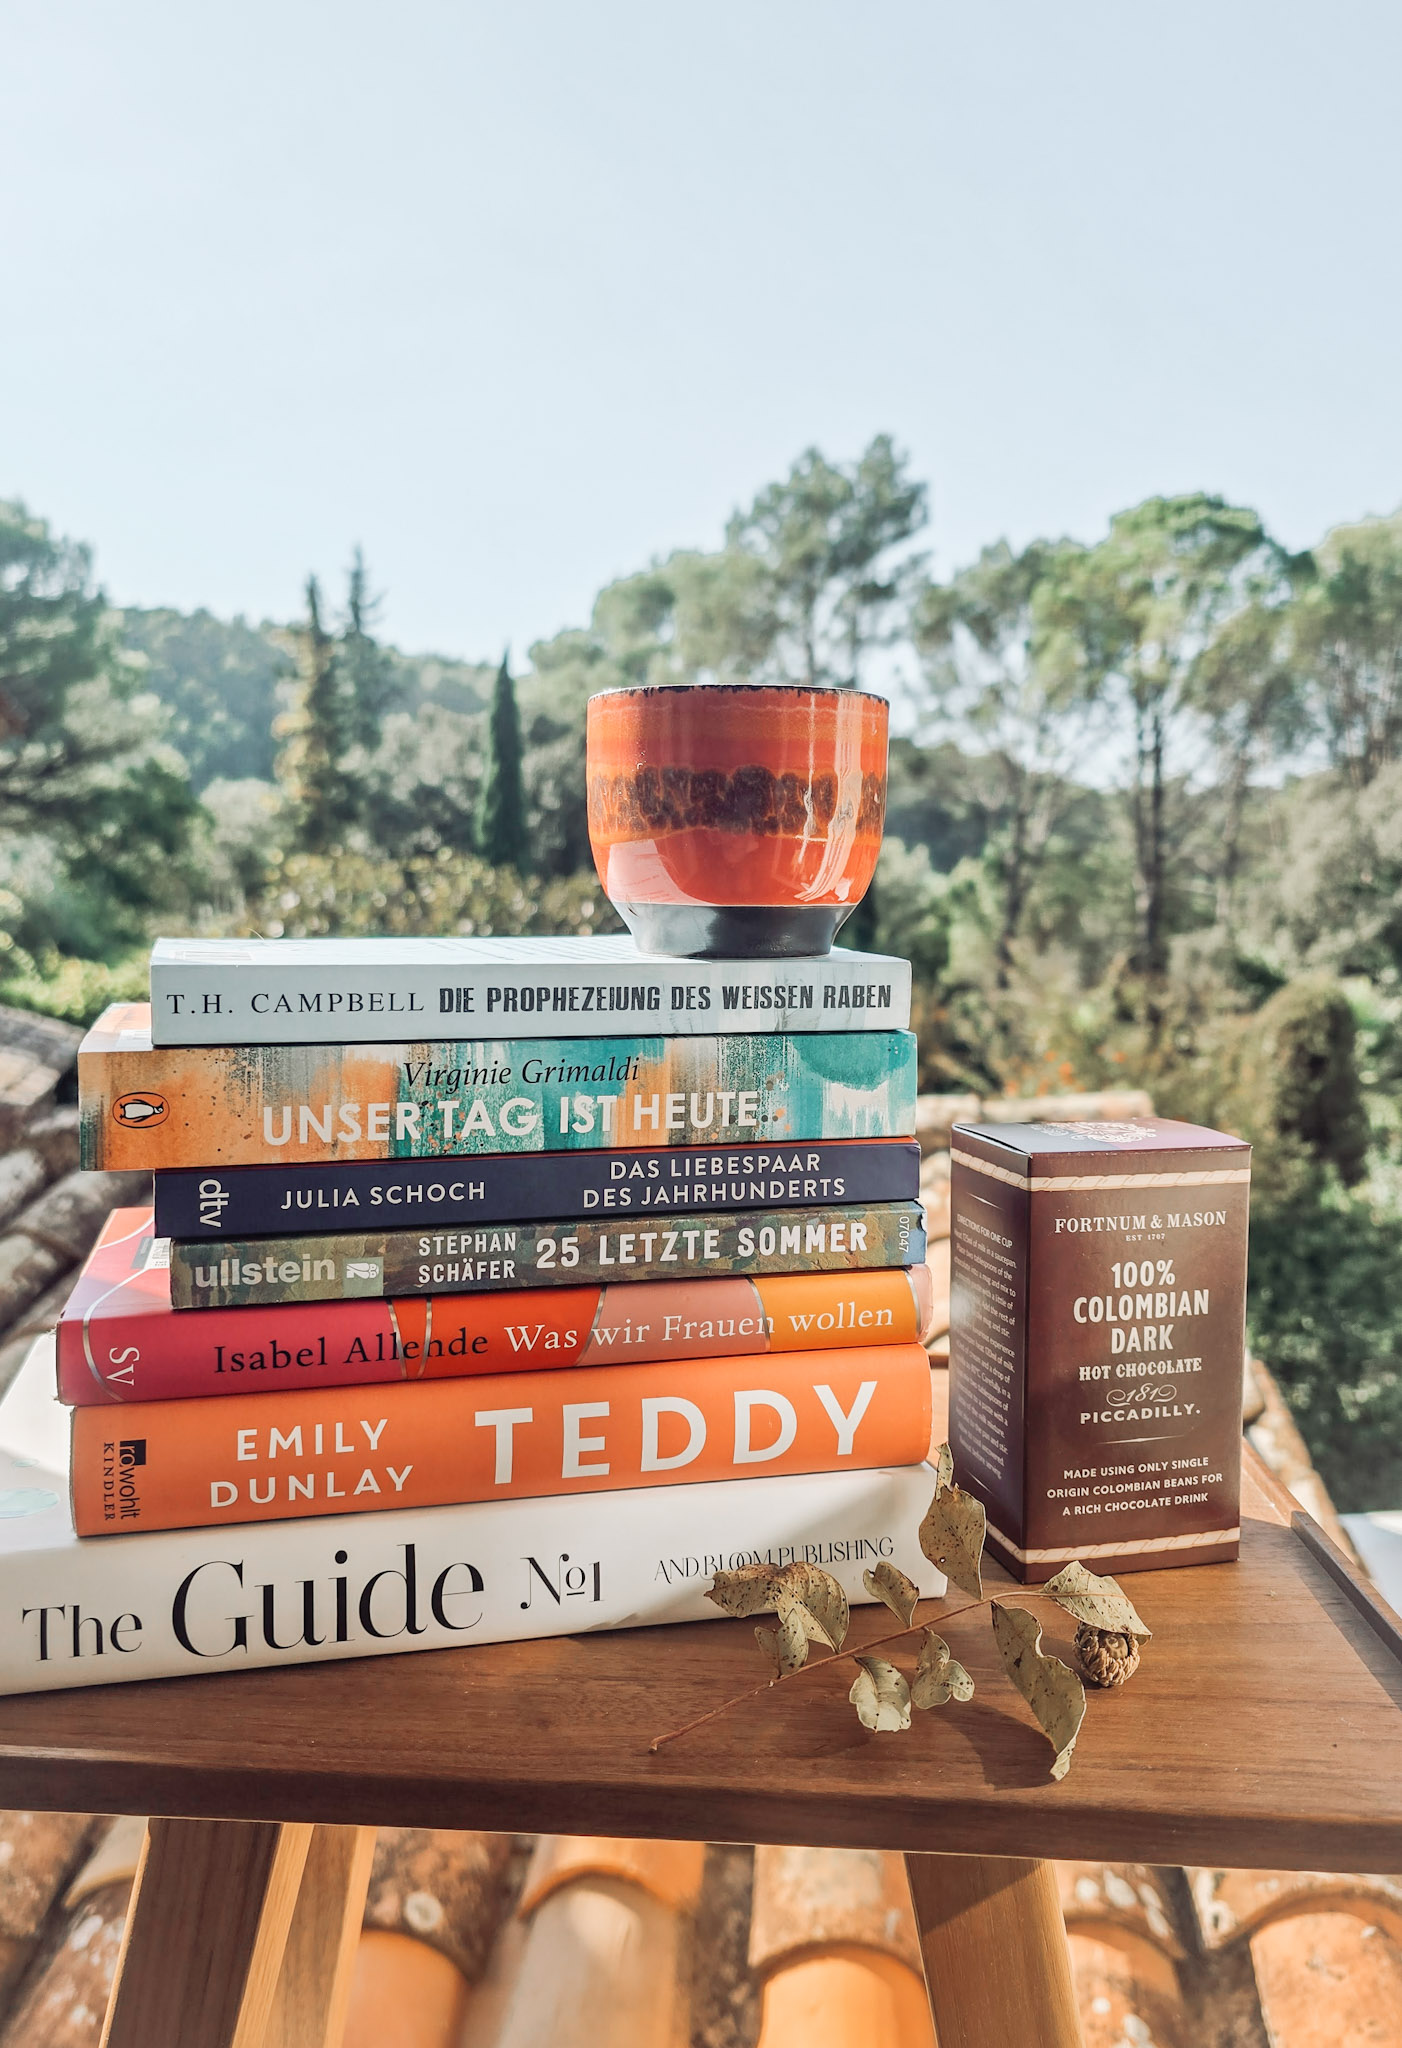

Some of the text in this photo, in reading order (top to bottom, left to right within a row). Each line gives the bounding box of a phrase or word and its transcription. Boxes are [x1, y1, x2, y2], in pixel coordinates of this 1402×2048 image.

[166, 984, 892, 1014] T.H. CAMPBELL DIE PROPHEZEIUNG DES WEISSEN RABEN
[404, 1056, 641, 1094] Virginie Grimaldi
[263, 1090, 758, 1146] UNSER TAG IST HEUTE
[611, 1153, 821, 1181] DAS LIEBESPAAR
[198, 1178, 230, 1228] dtv
[280, 1181, 486, 1210] JULIA SCHOCH
[583, 1177, 846, 1209] DES JAHRHUNDERTS
[898, 1216, 910, 1253] 07047
[1054, 1211, 1227, 1233] FORTNUM & MASON
[418, 1231, 516, 1256] STEPHAN
[536, 1222, 869, 1269] 25 LETZTE SOMMER
[990, 1231, 1001, 1243] ONE
[1001, 1237, 1012, 1247] CUP
[1125, 1234, 1143, 1242] EST
[194, 1256, 336, 1288] ullstein
[418, 1259, 516, 1284] SCHÄFER
[1003, 1271, 1012, 1280] the
[1111, 1259, 1176, 1289] 100%
[1009, 1288, 1016, 1296] to
[1073, 1289, 1209, 1324] COLOMBIAN
[214, 1302, 894, 1373] Isabel Allende Was wir Frauen wollen
[1111, 1324, 1174, 1354] DARK
[106, 1346, 140, 1386] SV
[1079, 1358, 1202, 1381] HOT CHOCOLATE
[1080, 1403, 1201, 1424] PICCADILLY.
[237, 1418, 388, 1461] EMILY
[474, 1380, 878, 1485] TEDDY
[104, 1442, 115, 1520] KINDLER
[119, 1445, 141, 1520] rowohlt
[1063, 1457, 1209, 1480] MADE USING ONLY SINGLE
[210, 1465, 414, 1508] DUNLAY
[1046, 1473, 1223, 1498] ORIGIN COLOMBIAN BEANS FOR
[1062, 1492, 1209, 1516] A RICH CHOCOLATE DRINK
[654, 1557, 699, 1584] AND
[779, 1537, 894, 1568] PUBLISHING
[22, 1604, 143, 1662] The
[171, 1543, 485, 1658] Guide
